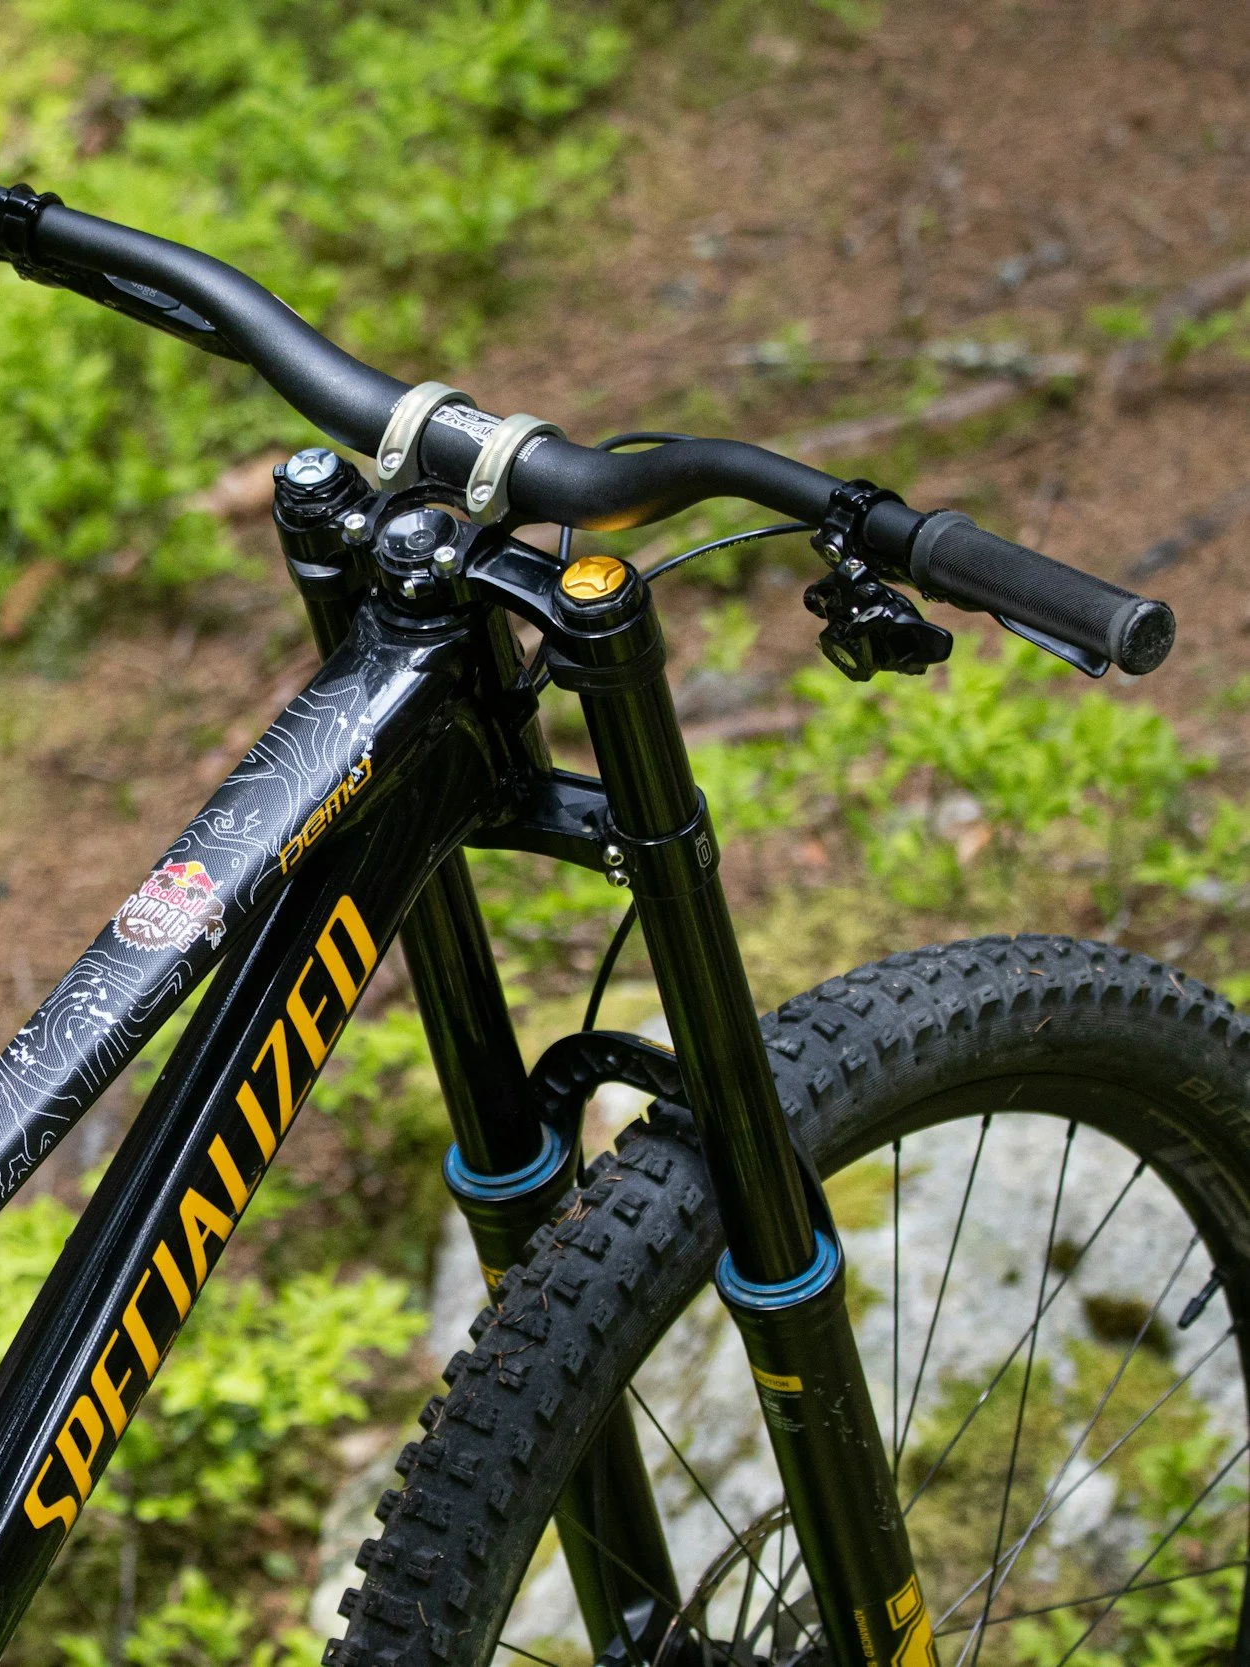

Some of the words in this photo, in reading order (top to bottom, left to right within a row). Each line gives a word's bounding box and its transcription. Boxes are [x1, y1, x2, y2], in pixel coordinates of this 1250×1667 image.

[114, 893, 202, 953] RAMPAGE
[23, 894, 378, 1533] SPECIALIZED
[853, 1608, 875, 1658] ADVANCED
